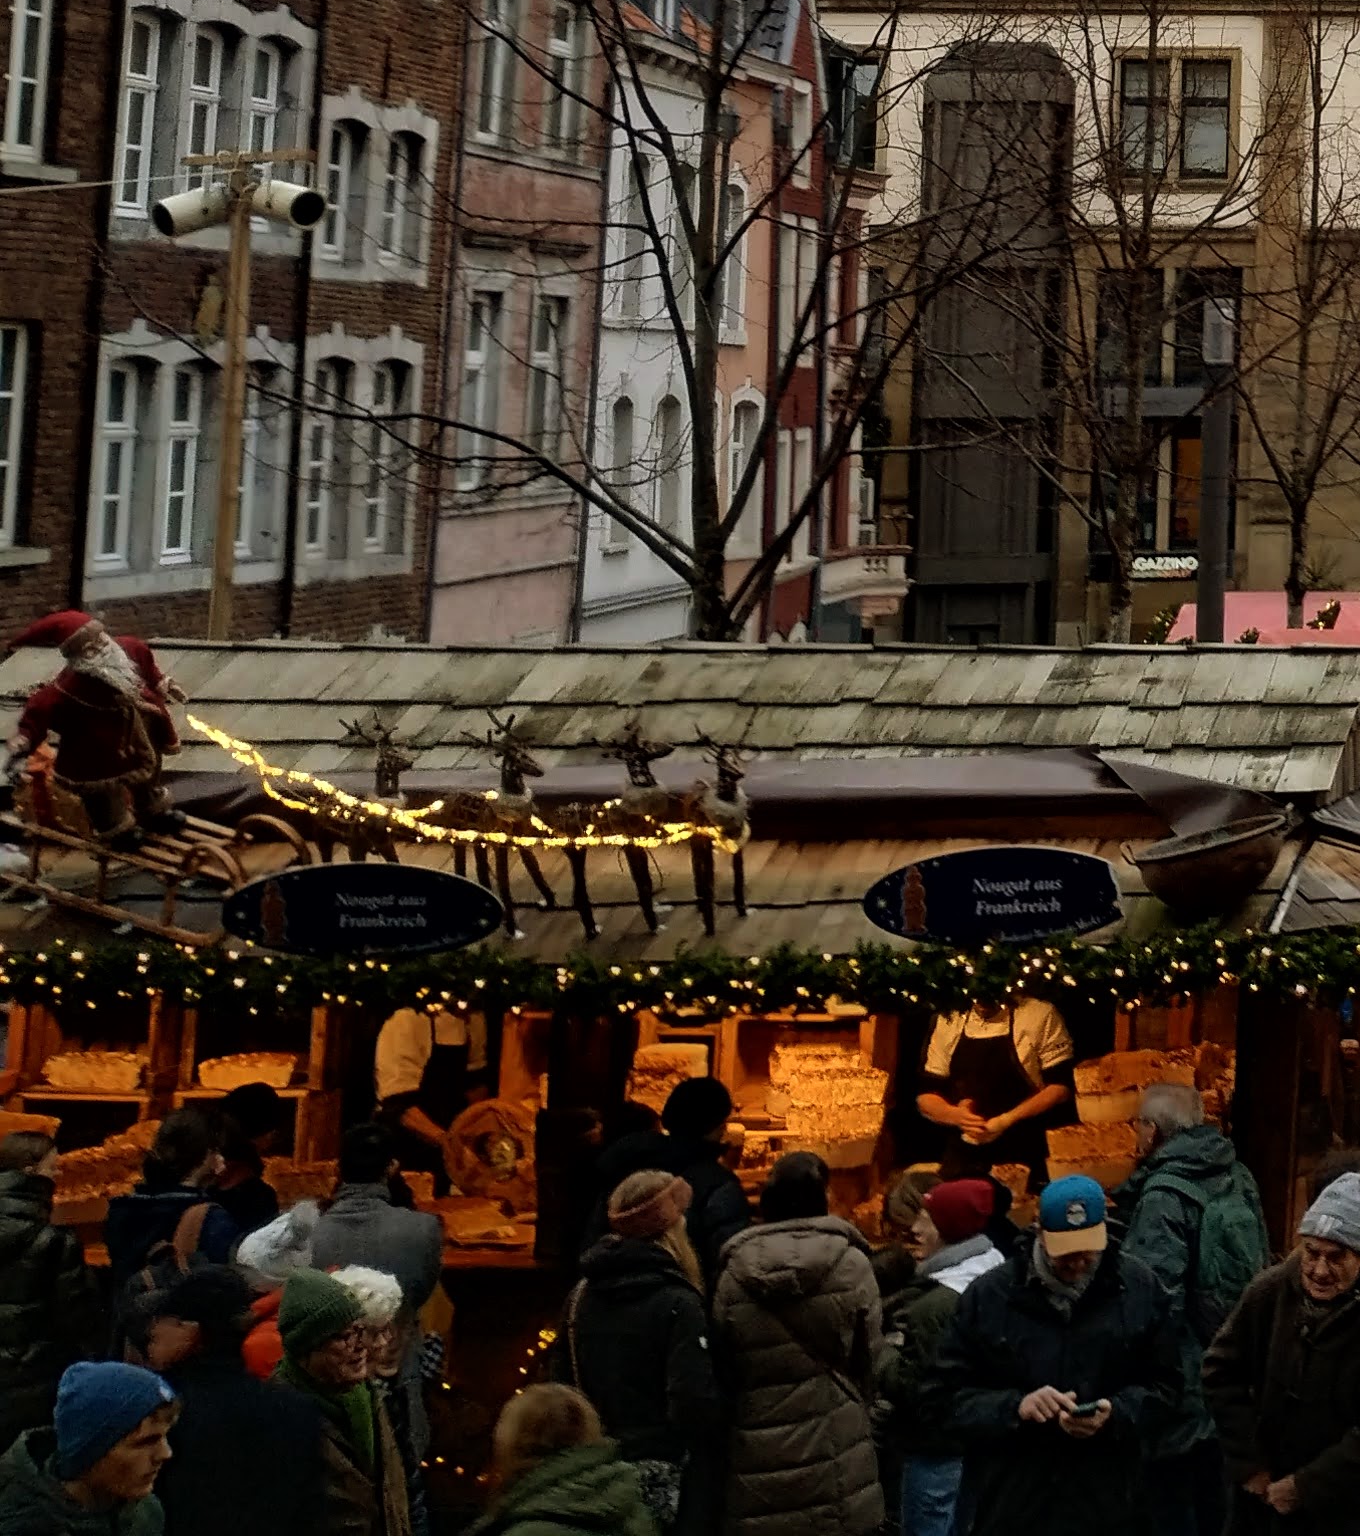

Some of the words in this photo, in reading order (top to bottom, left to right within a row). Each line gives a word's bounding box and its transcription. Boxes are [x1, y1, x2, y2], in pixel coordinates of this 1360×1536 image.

[972, 878, 1031, 898] Nougat
[1034, 878, 1064, 892] aus
[336, 893, 396, 911] Nougat
[398, 896, 427, 906] aus
[975, 897, 1062, 916] Frankreich
[339, 913, 427, 928] Frankreich
